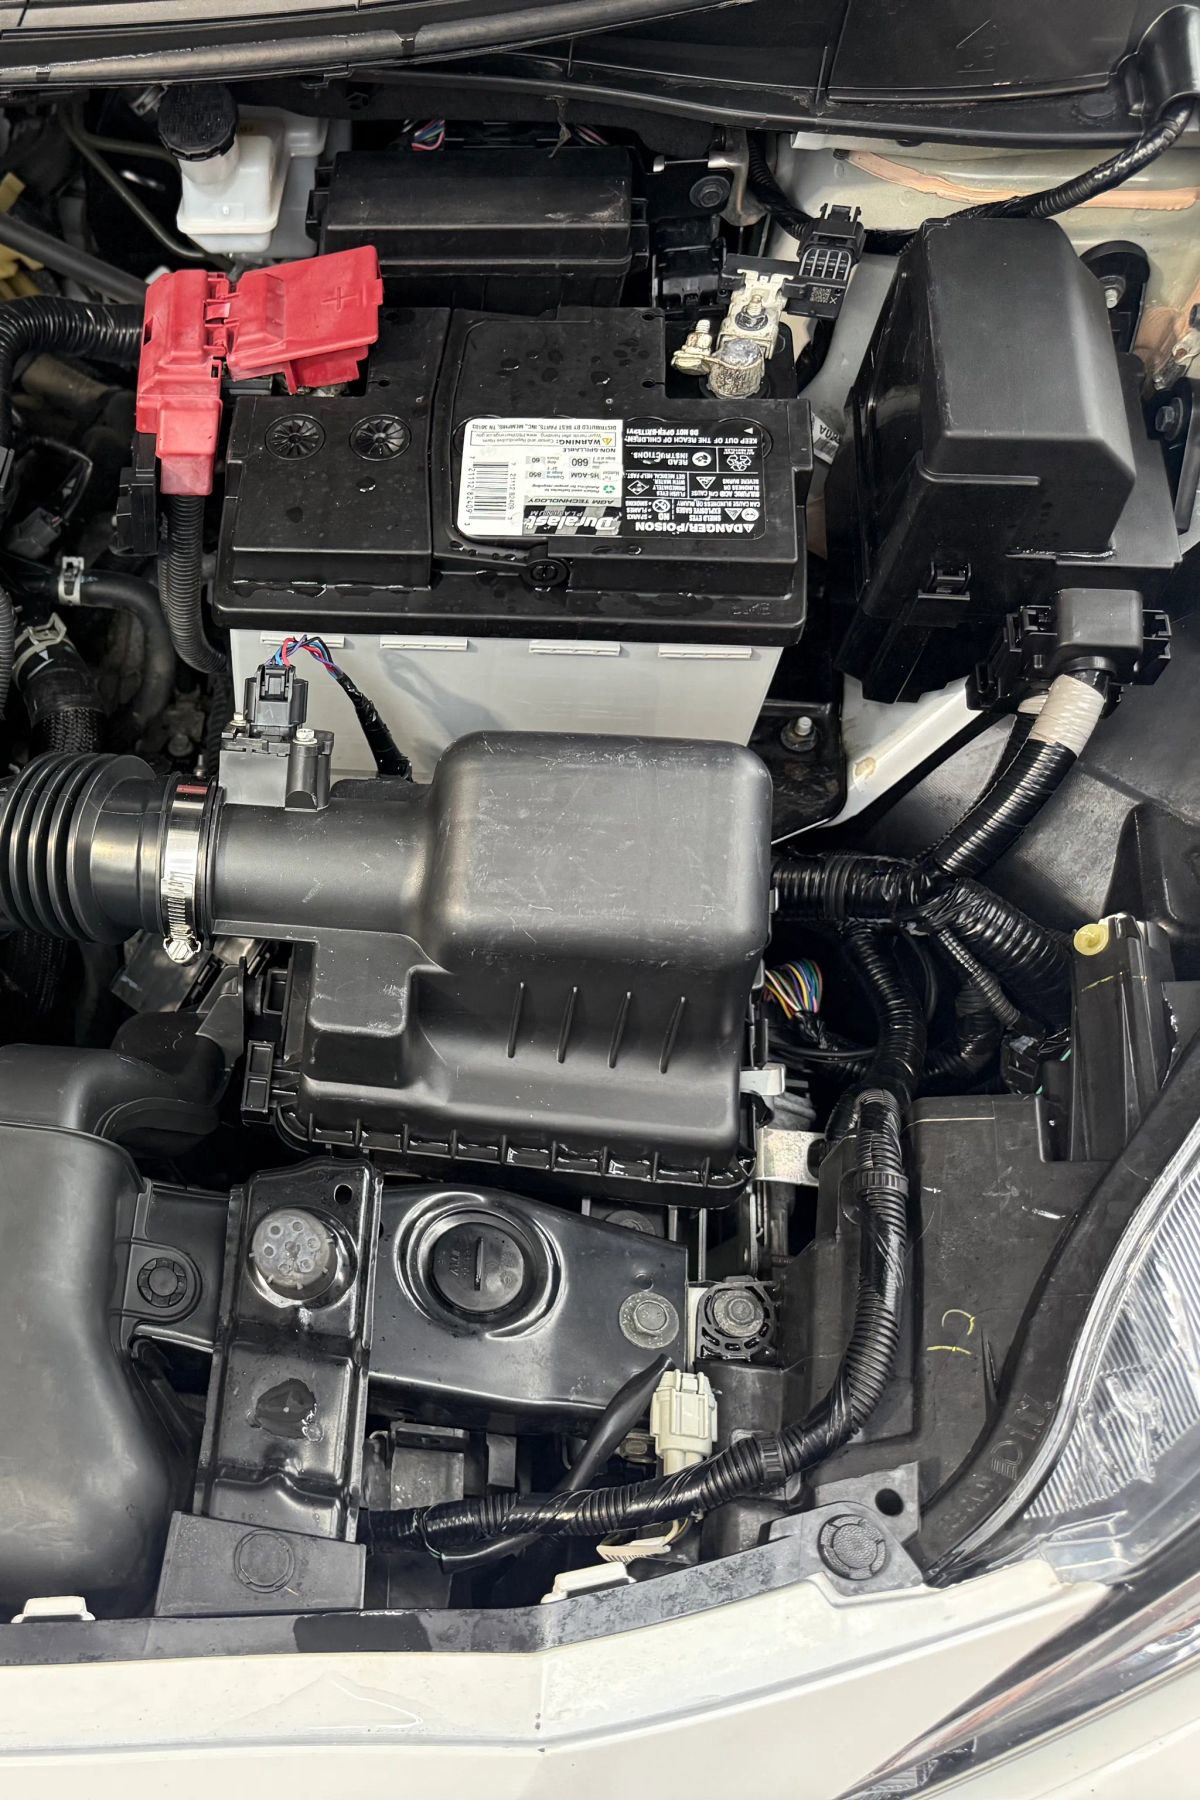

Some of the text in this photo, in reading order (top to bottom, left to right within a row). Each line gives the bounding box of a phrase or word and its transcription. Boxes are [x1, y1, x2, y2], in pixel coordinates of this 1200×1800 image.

[572, 458, 588, 466] 680
[525, 516, 616, 530] Duralast
[635, 522, 743, 533] DANGER/POISON
